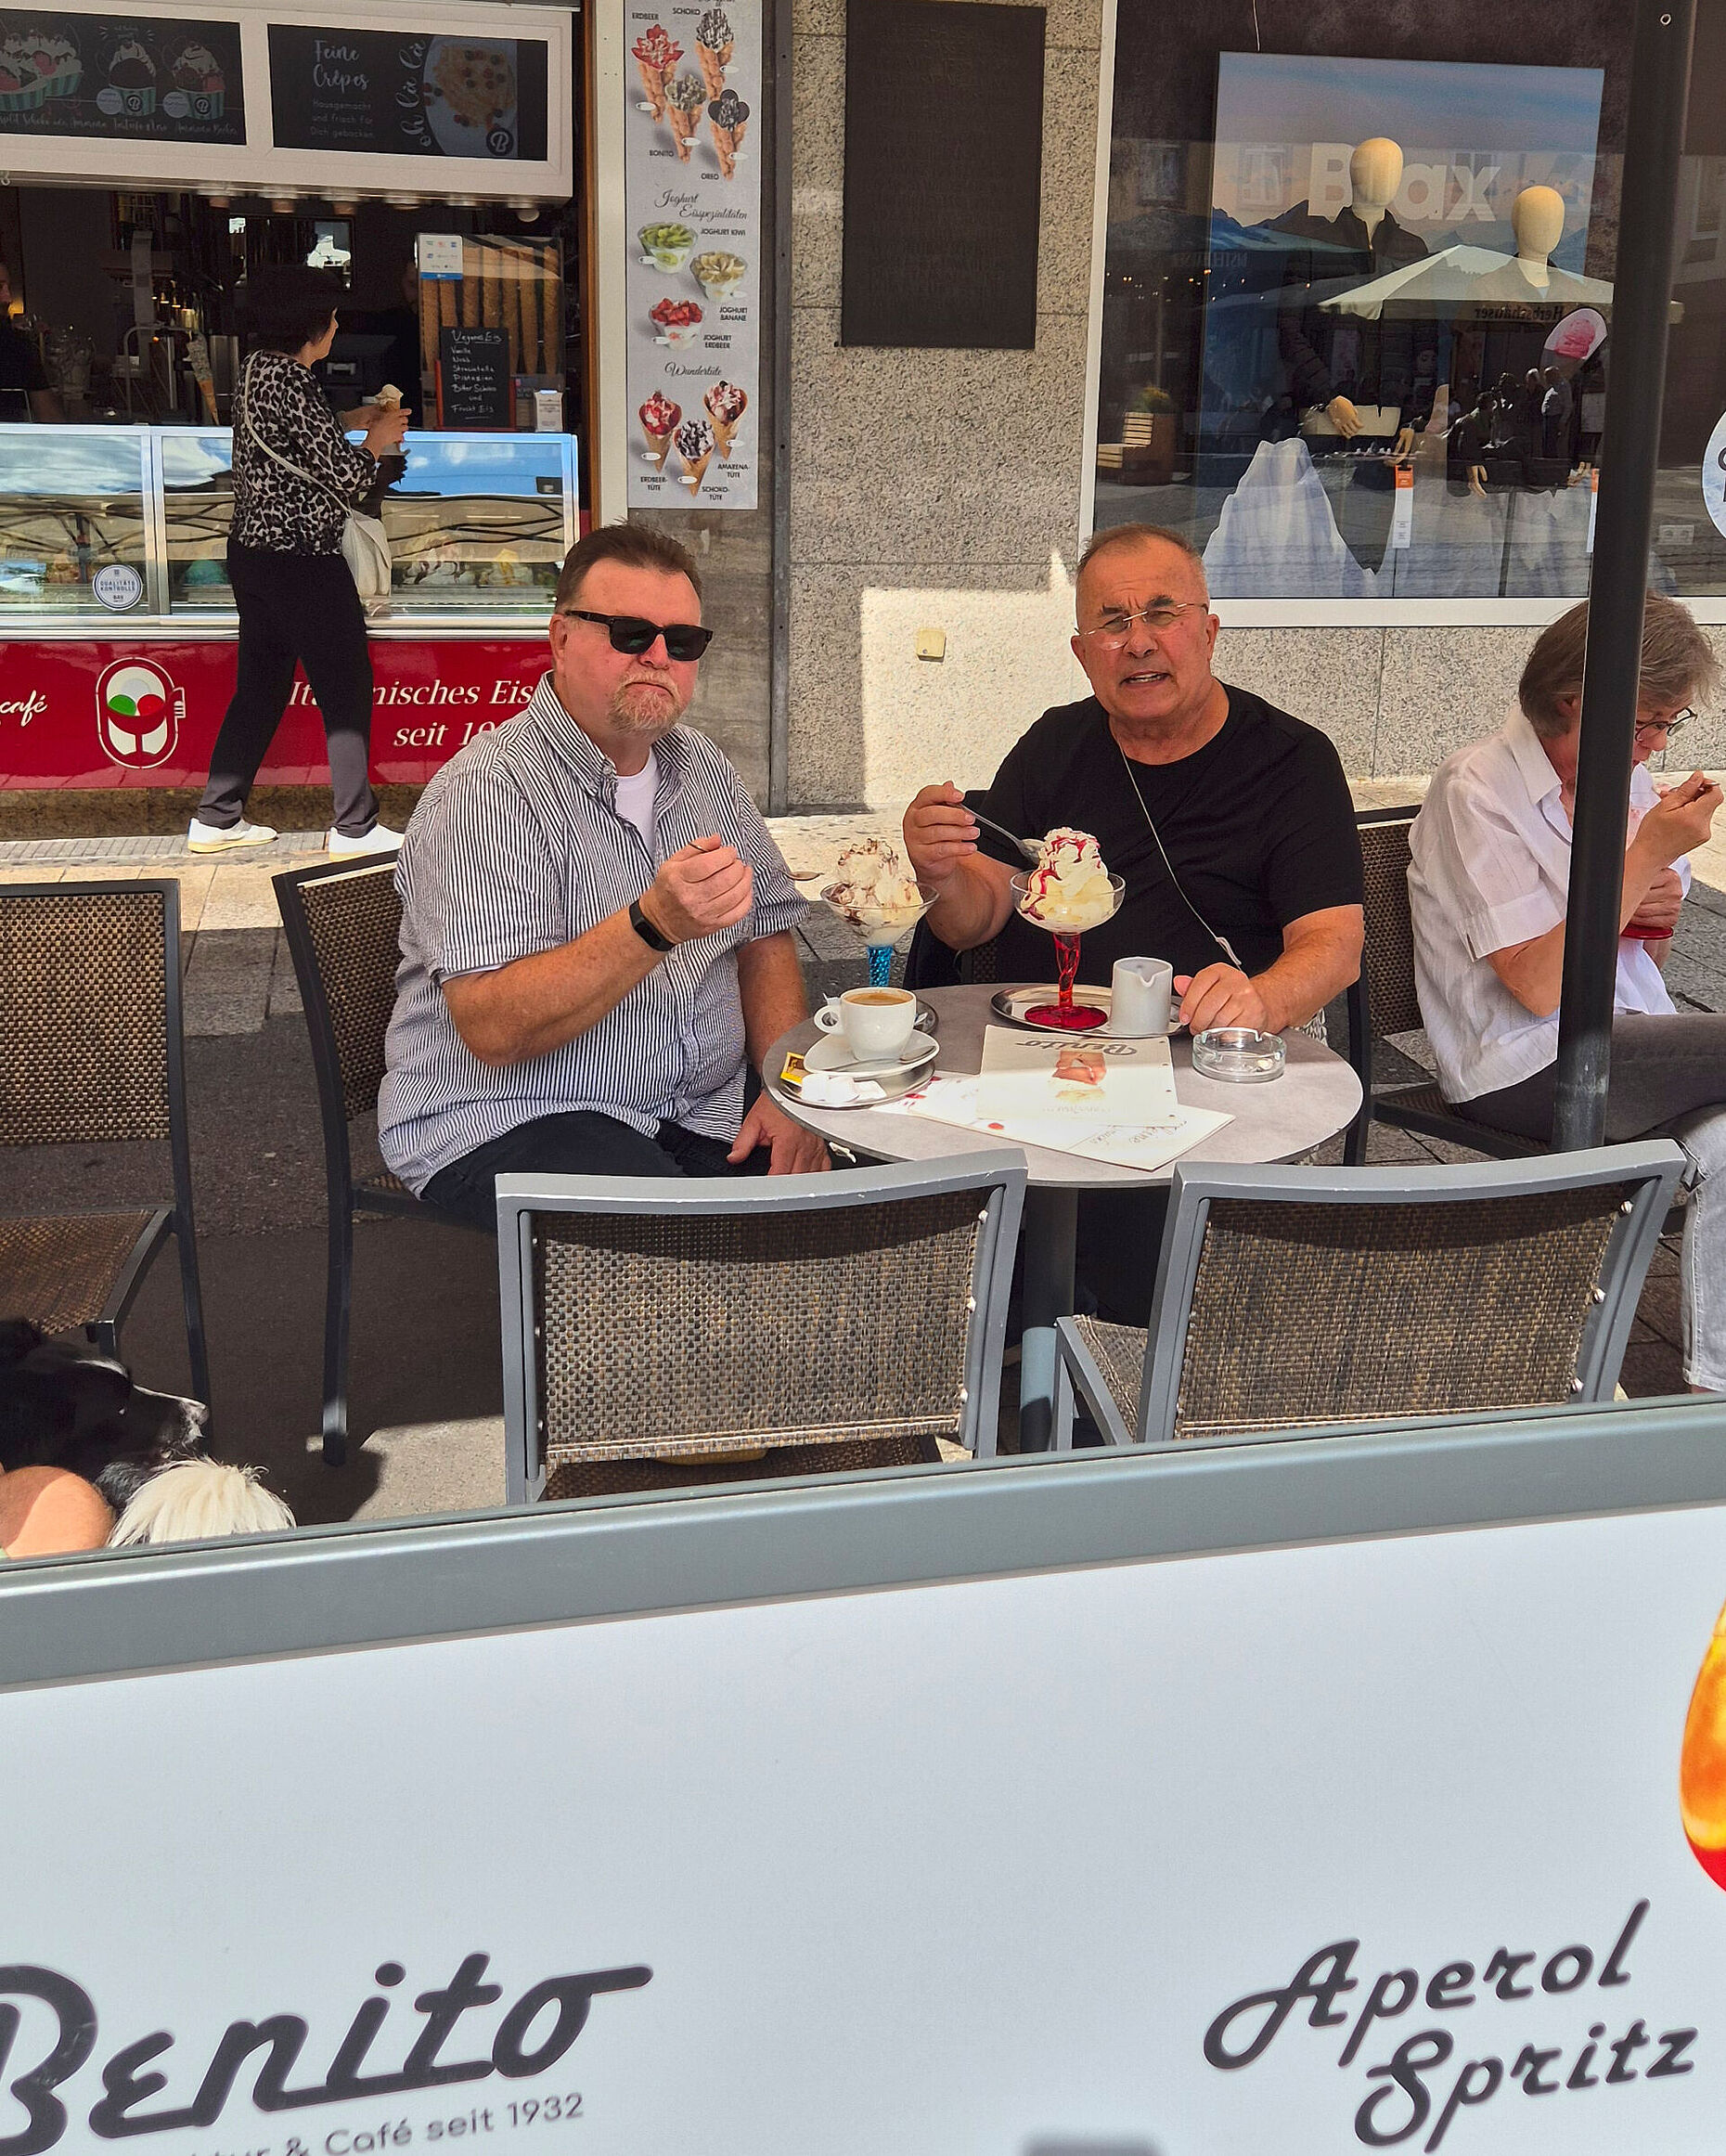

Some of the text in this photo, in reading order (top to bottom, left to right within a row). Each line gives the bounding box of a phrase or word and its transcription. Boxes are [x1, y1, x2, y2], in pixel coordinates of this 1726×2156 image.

[314, 39, 360, 62] Feine
[313, 63, 369, 94] Crêpes
[654, 188, 699, 208] Joghurt
[1307, 142, 1501, 223] Bax
[393, 721, 449, 747] seit
[1016, 1039, 1138, 1056] Benito
[1203, 1897, 1651, 2072] Aperol
[1354, 2018, 1699, 2154] Spritz
[325, 2114, 412, 2155] Café
[425, 2107, 495, 2142] seit
[507, 2091, 585, 2128] 1932
